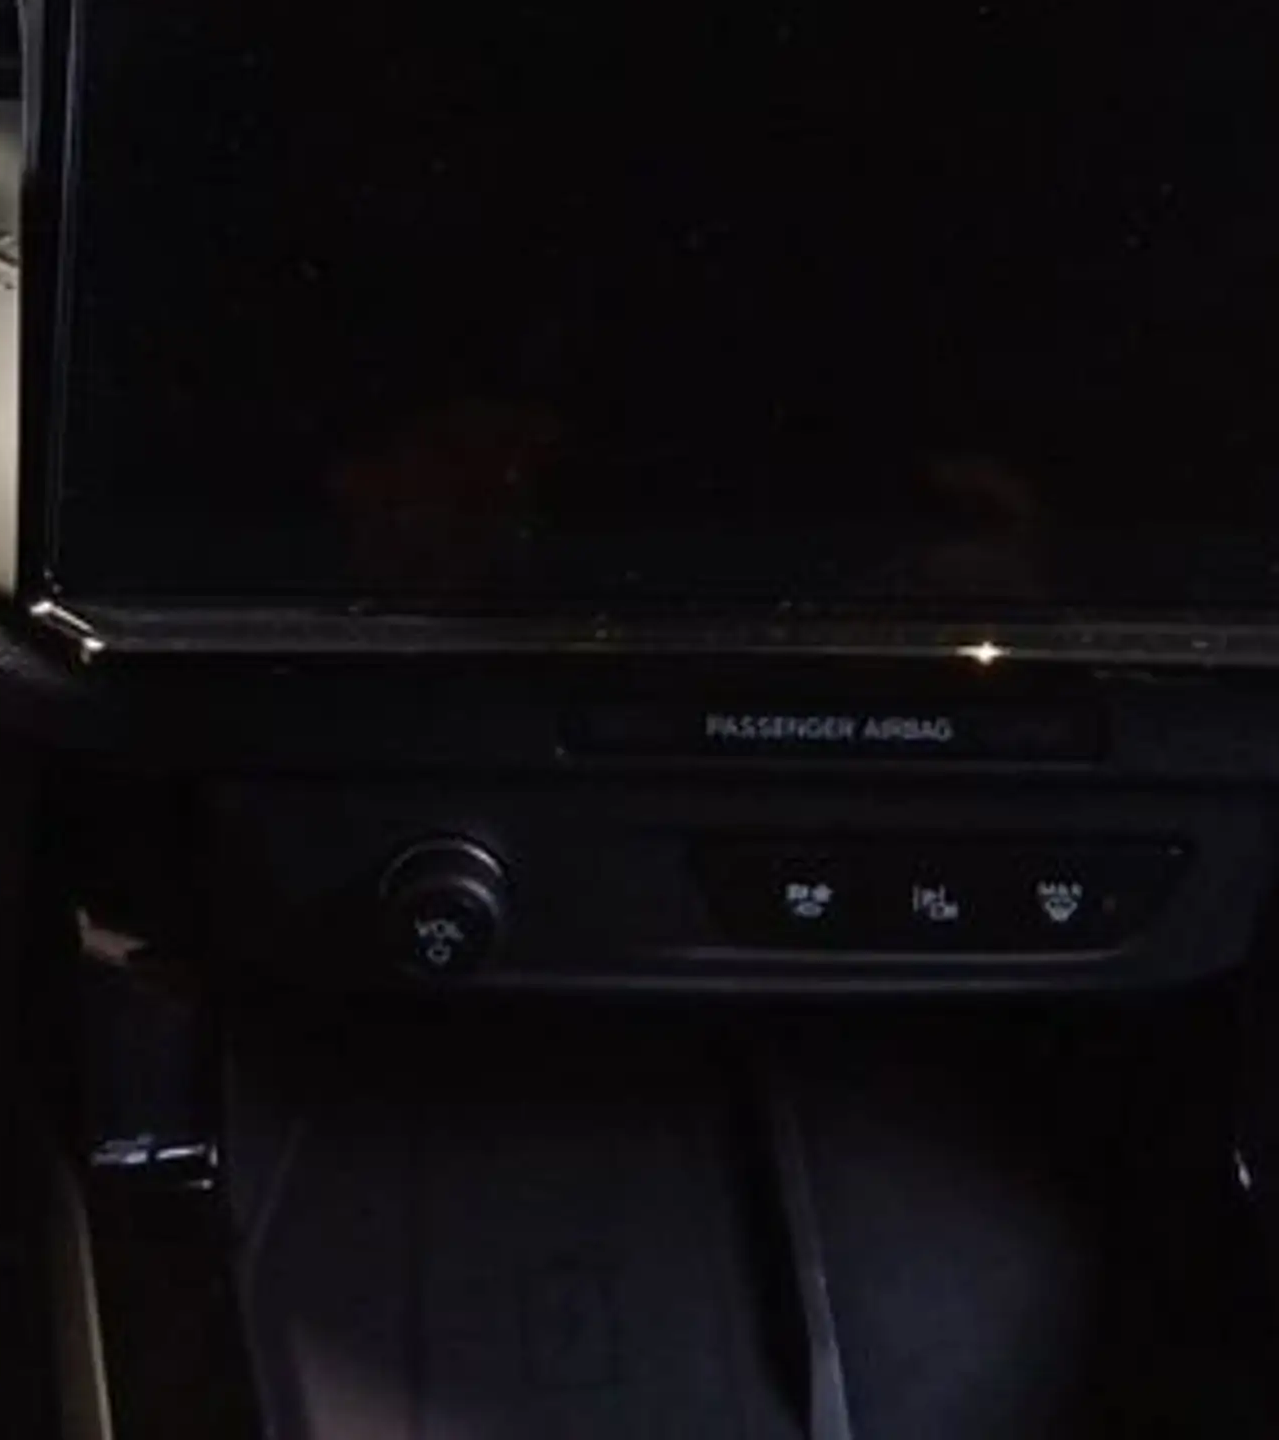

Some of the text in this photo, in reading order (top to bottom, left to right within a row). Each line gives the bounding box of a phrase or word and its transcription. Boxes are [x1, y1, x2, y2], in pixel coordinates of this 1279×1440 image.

[706, 714, 955, 742] PASSENGER AIRBAG
[413, 916, 465, 942] VOL
